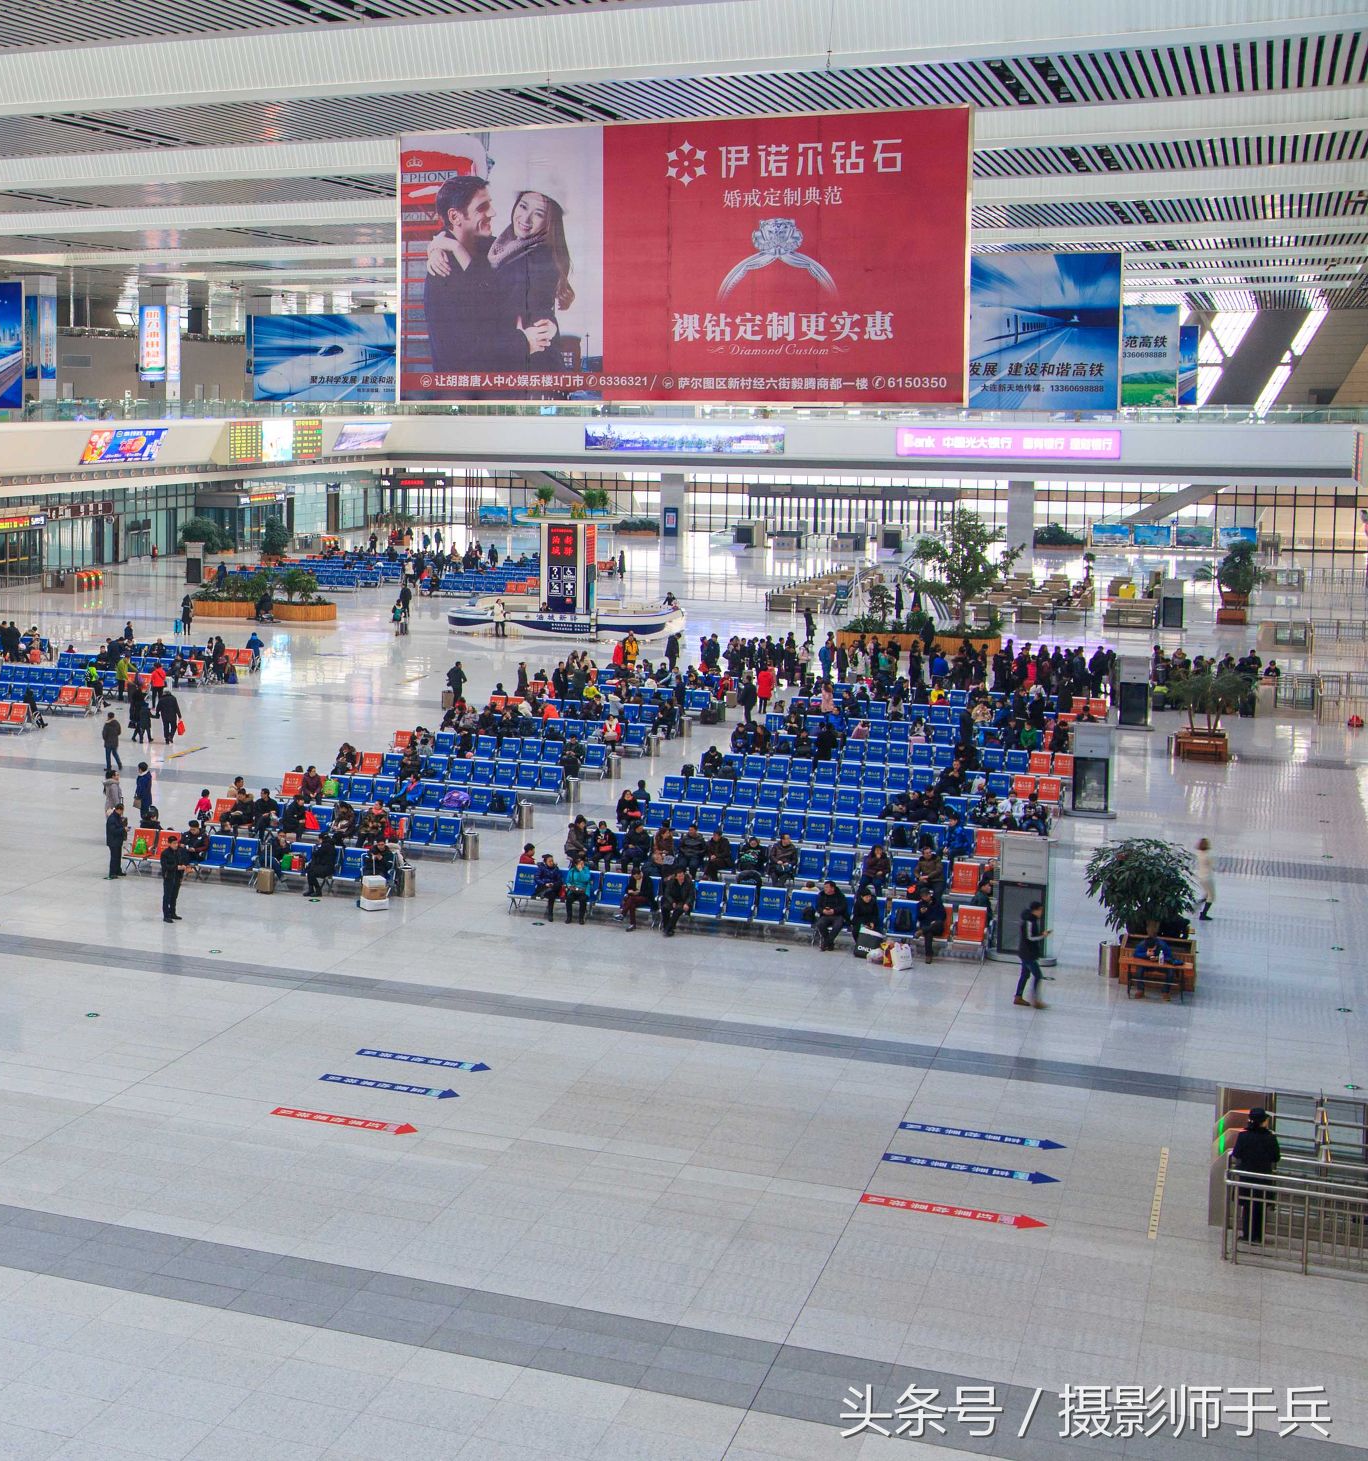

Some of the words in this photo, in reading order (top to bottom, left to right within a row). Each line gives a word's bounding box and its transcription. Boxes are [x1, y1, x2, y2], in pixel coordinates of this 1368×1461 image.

[718, 139, 903, 179] 伊诺尔钻石
[722, 185, 844, 208] 婚戒定制典范
[671, 311, 895, 342] 裸钻定制更实惠
[1122, 336, 1168, 348] 范高铁
[728, 344, 785, 356] Diamond
[785, 344, 829, 356] Custom
[1007, 362, 1105, 377] 建设和谐高铁
[309, 375, 358, 385] 聚力科学发展
[361, 375, 396, 385] 建设和谐
[434, 375, 584, 388] 让胡路唐人中心娱乐楼1门市
[599, 376, 647, 387] 6336321
[677, 376, 869, 390] 萨尔图区新村经六街毅腾商都一楼
[887, 377, 948, 389] 6150350
